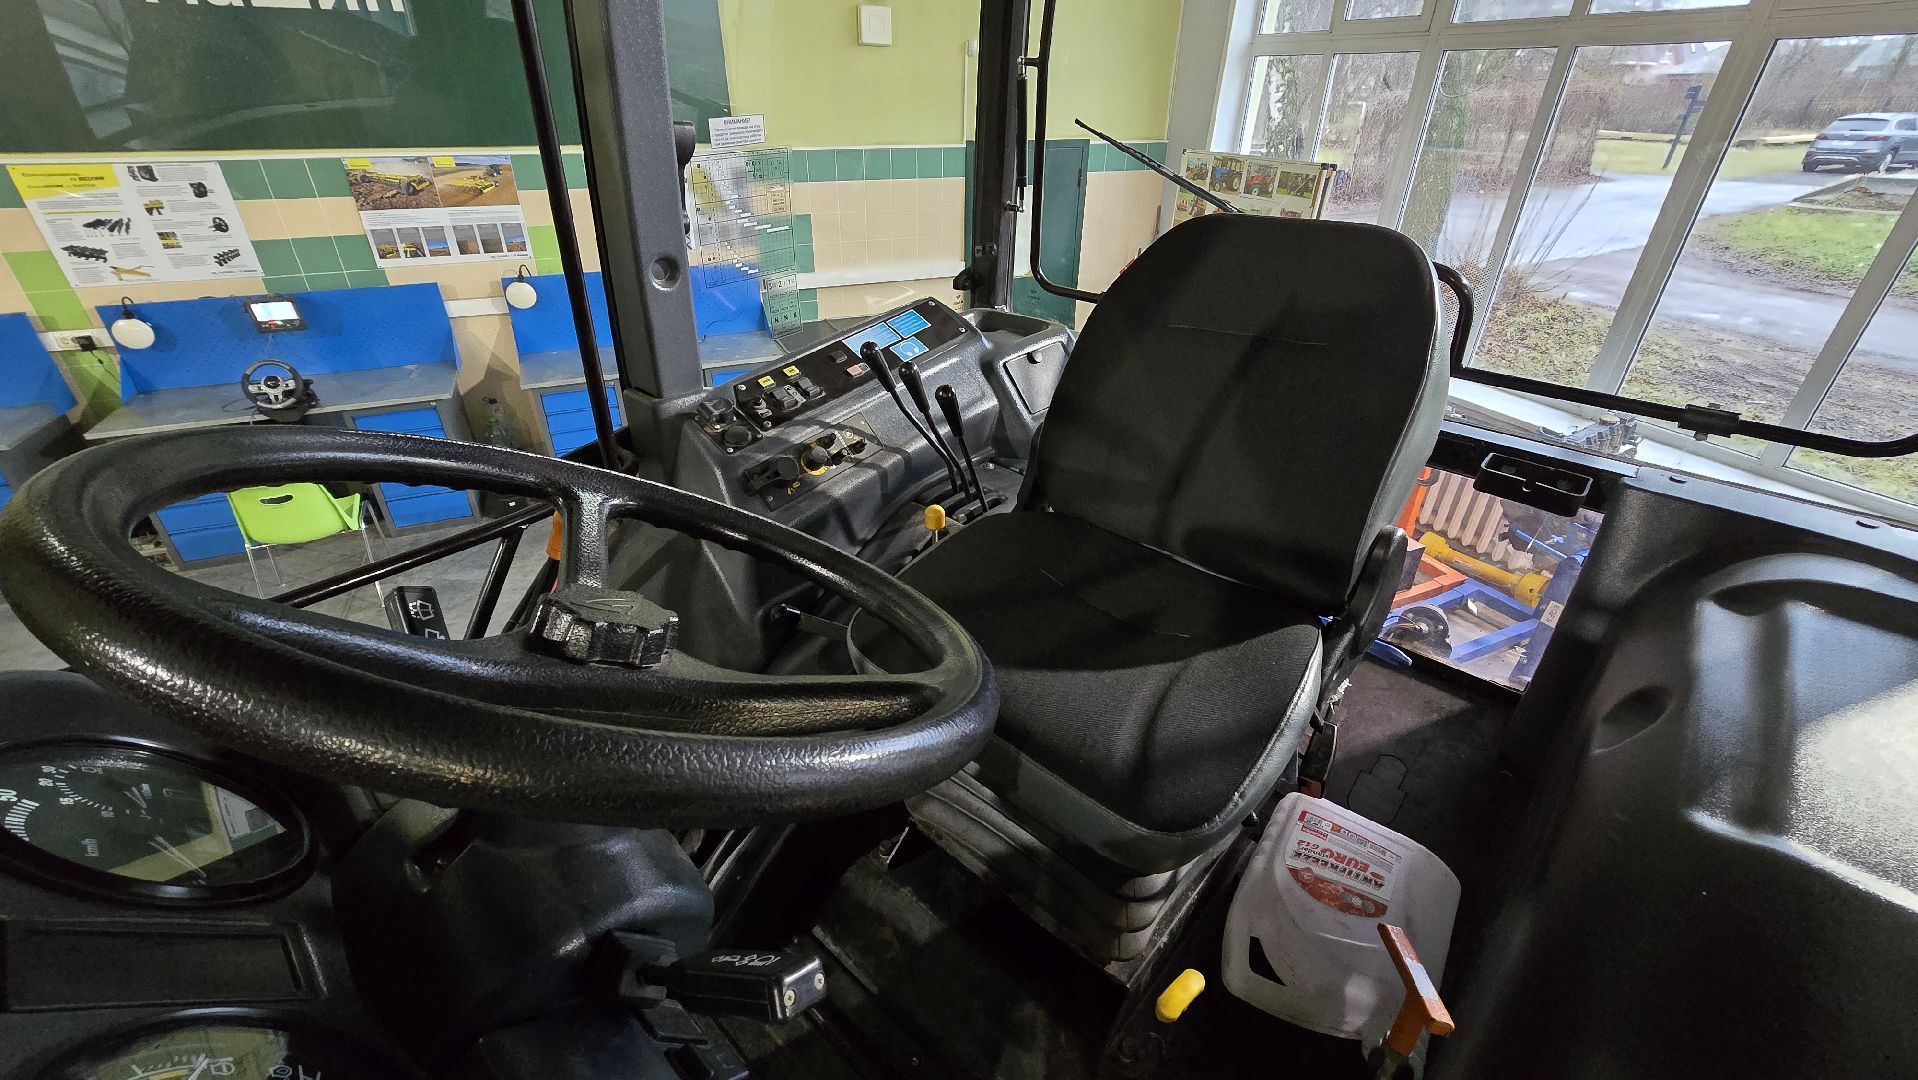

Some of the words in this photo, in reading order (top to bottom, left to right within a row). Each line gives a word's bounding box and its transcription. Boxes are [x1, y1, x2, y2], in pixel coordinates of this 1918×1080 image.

[80, 838, 100, 857] km/h
[1296, 839, 1320, 850] G12
[1289, 849, 1385, 892] ANTIFREEZE
[1320, 847, 1371, 874] EURO
